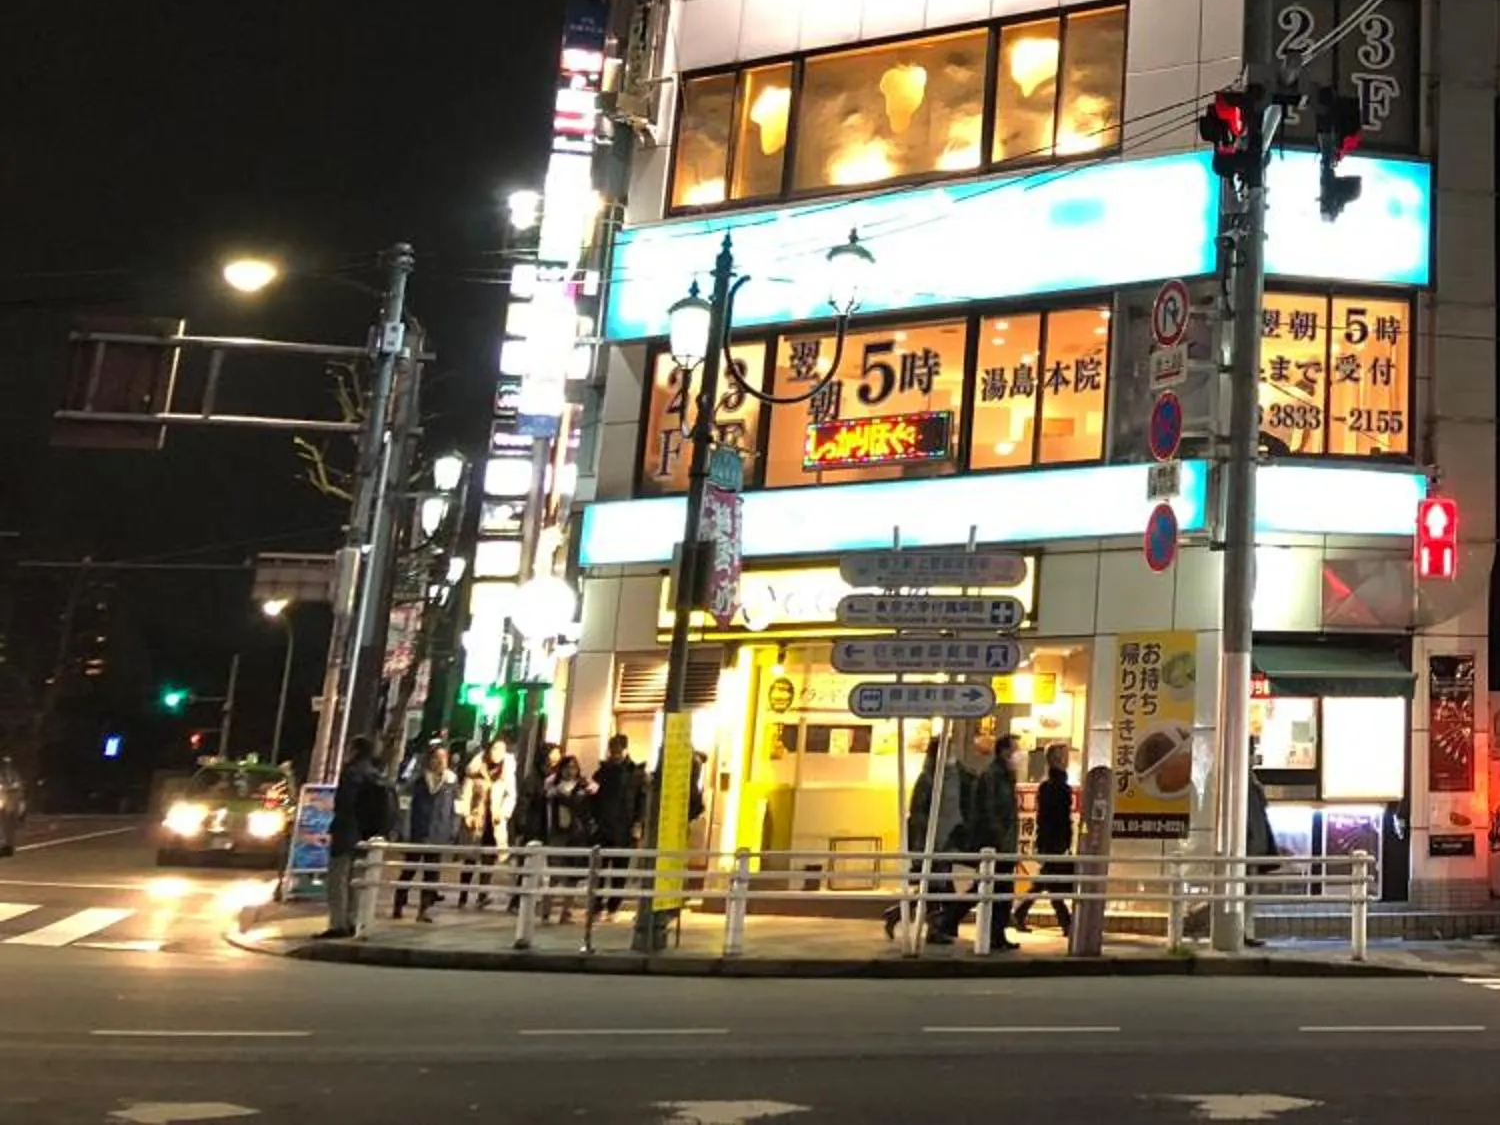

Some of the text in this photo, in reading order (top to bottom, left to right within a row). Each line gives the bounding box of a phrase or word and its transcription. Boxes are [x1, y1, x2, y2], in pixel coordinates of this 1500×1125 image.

[981, 357, 1103, 403] 湯島本院
[1139, 641, 1162, 716] お持ち
